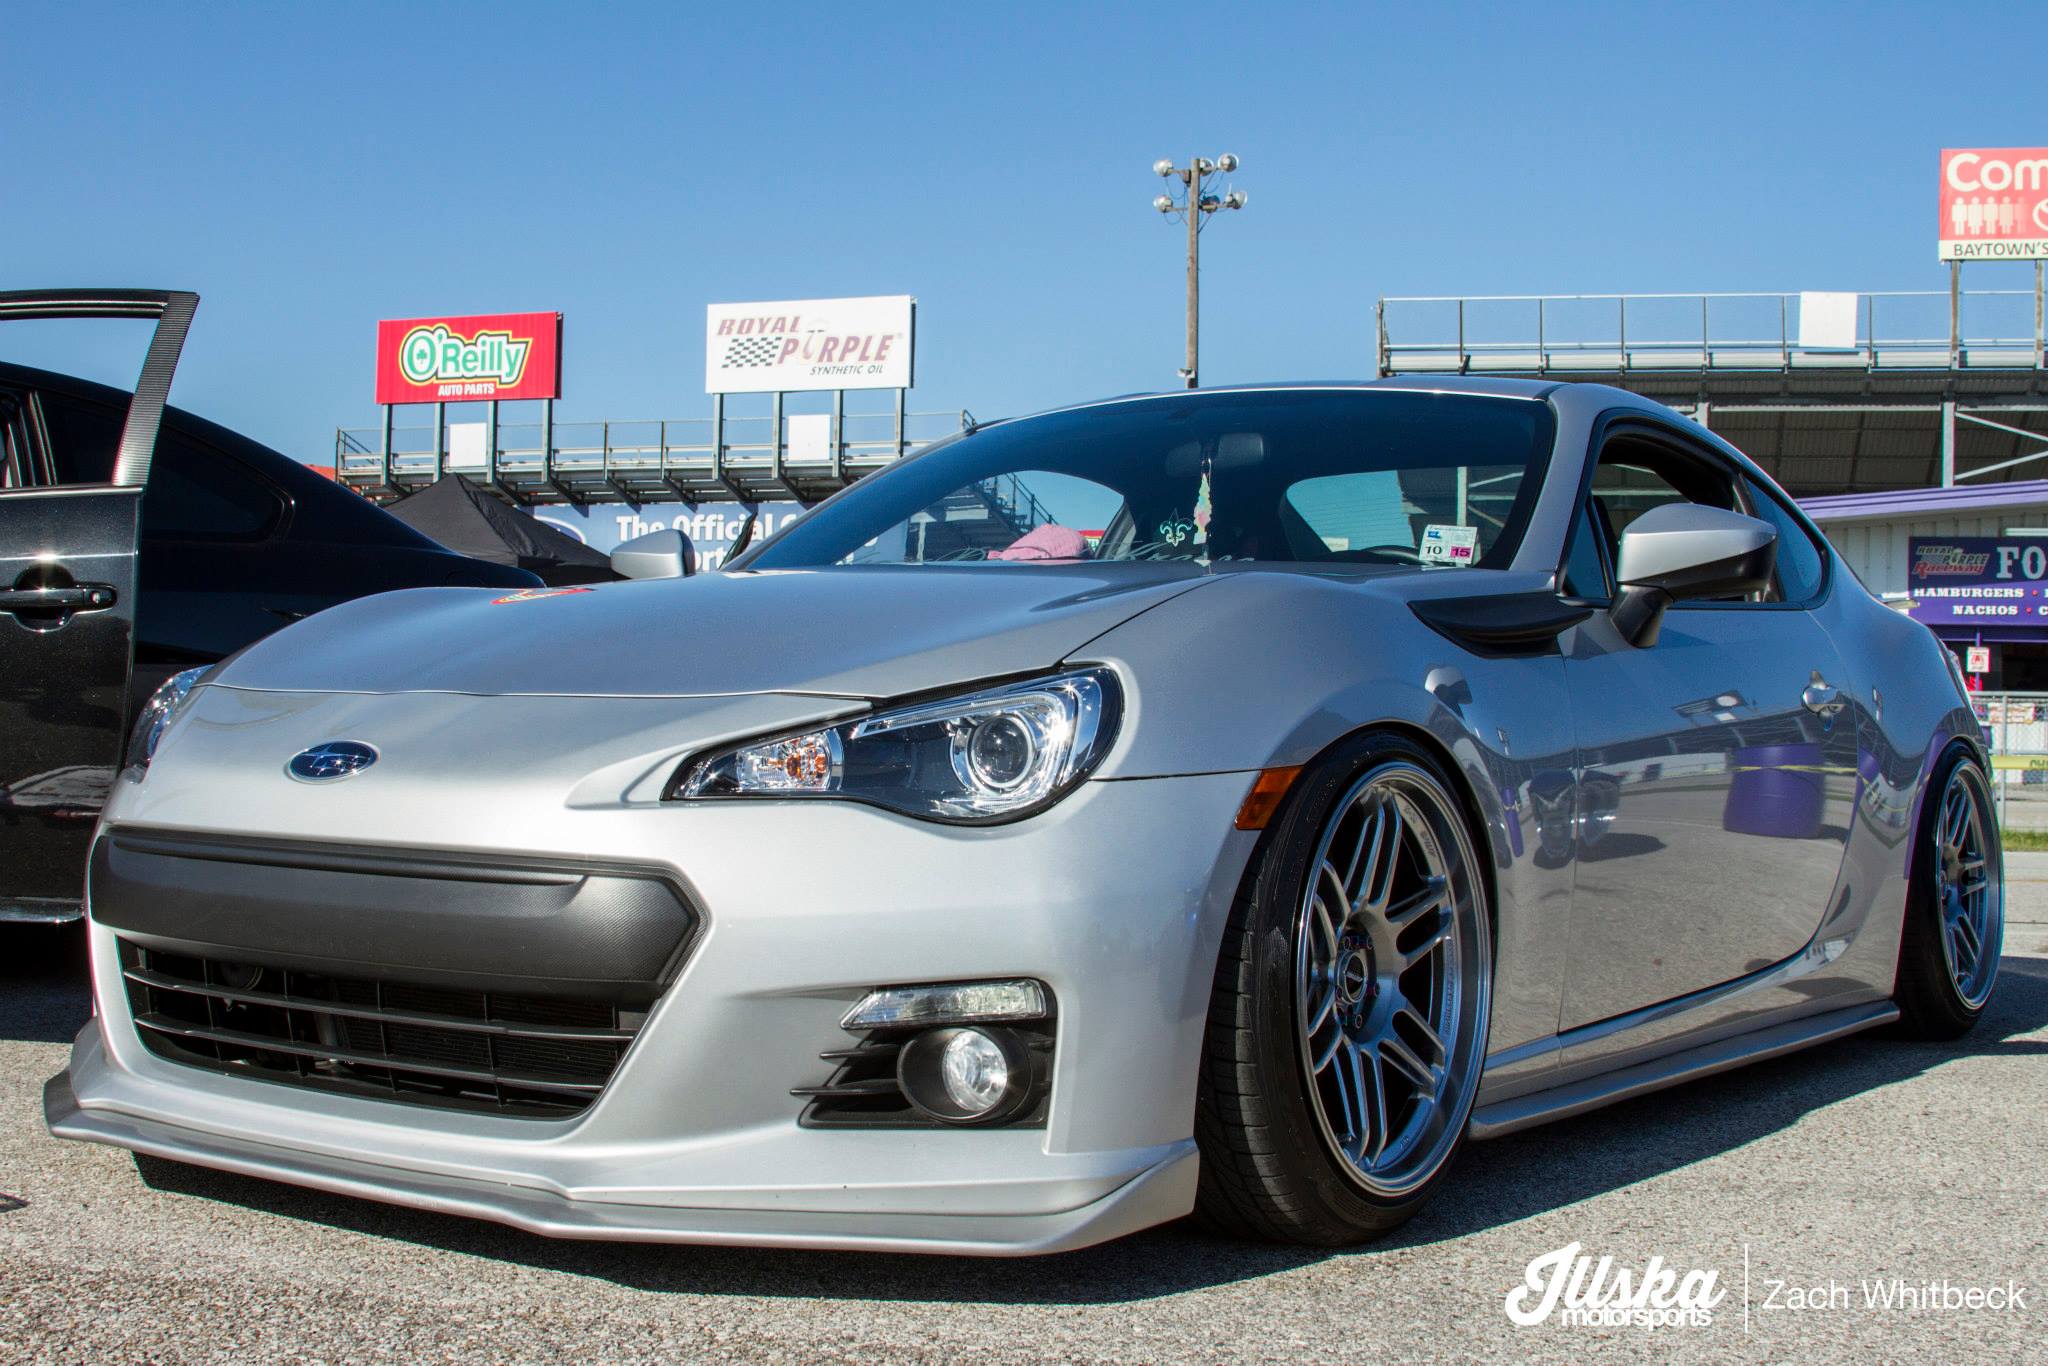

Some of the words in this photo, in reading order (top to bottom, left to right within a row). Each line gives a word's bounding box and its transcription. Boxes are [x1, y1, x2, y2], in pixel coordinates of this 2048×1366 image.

[717, 316, 801, 336] ROYAL
[405, 331, 522, 379] O'Reilly
[777, 333, 894, 364] PURPLE
[810, 365, 863, 376] SYNTHETIC
[867, 364, 884, 374] OIL
[438, 384, 463, 397] AUTO
[464, 383, 495, 396] PARTS
[1425, 545, 1442, 555] 10
[1913, 587, 2025, 598] HAMBURGERS
[1952, 605, 2018, 615] NACHOS
